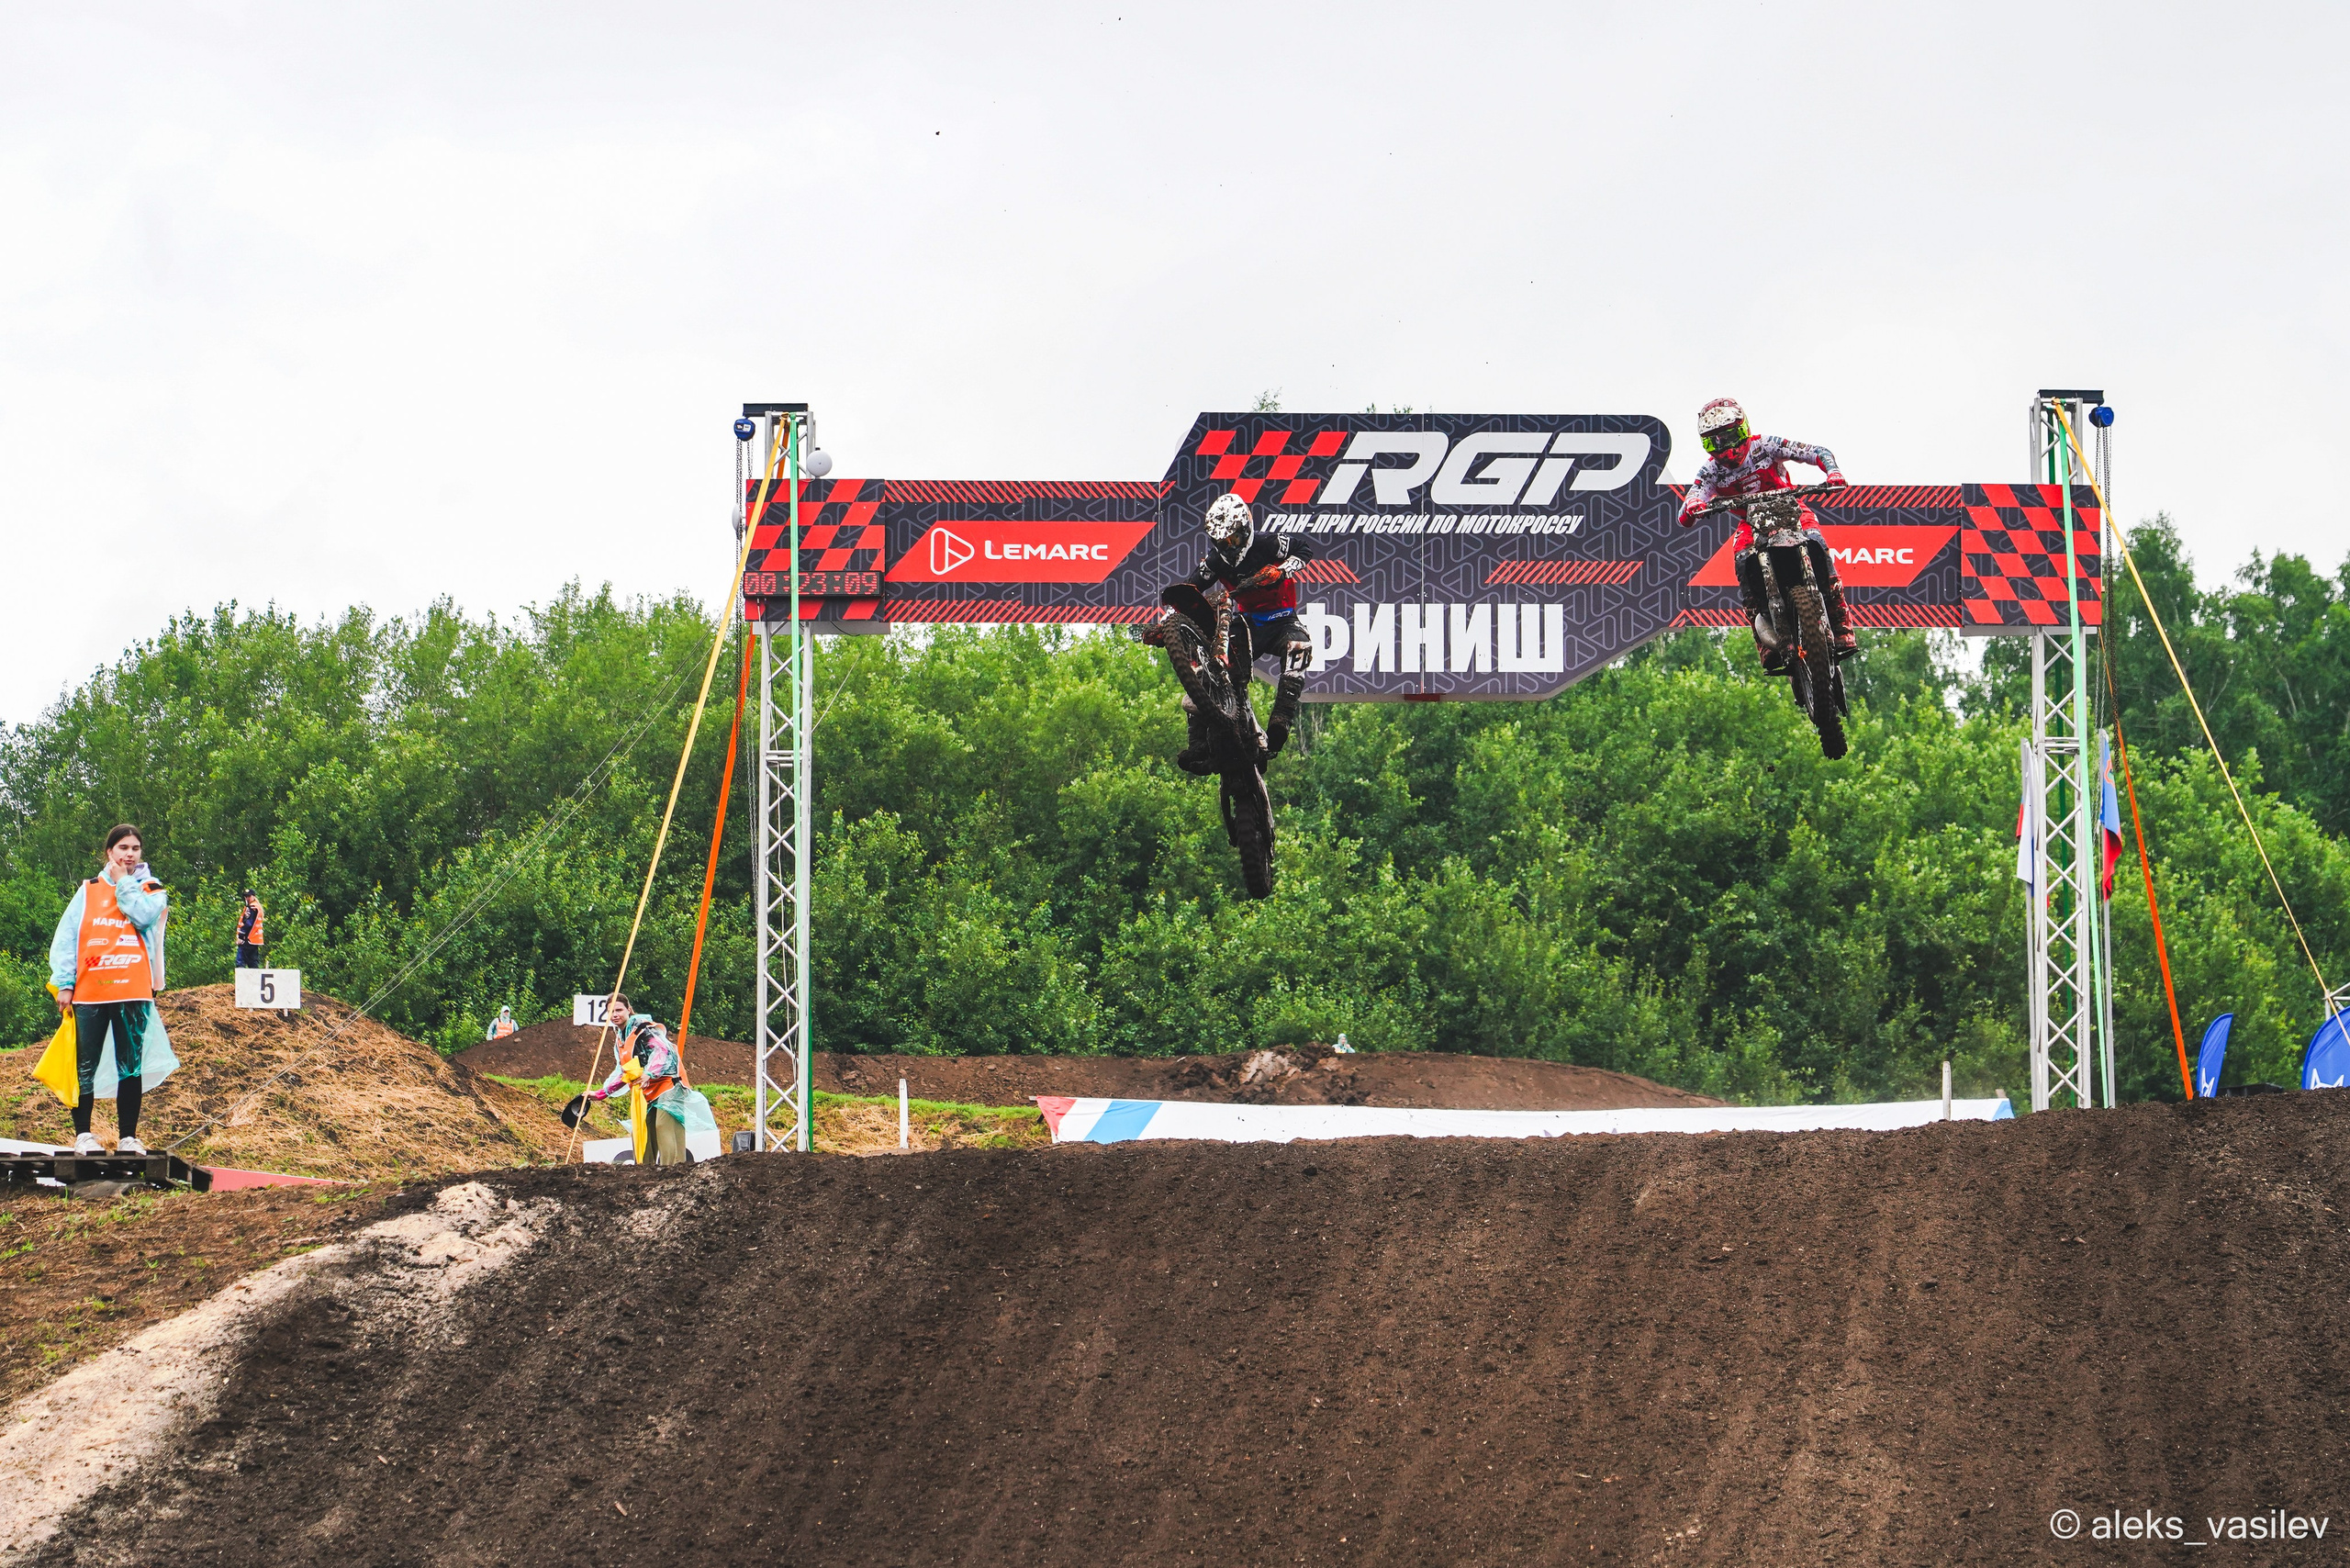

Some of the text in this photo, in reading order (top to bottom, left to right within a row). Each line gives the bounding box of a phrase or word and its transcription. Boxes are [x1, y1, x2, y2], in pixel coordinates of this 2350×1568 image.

[1316, 431, 1651, 506] RGP
[1260, 513, 1584, 534] ГРАН-ПРИ РОССИИ ПО МОТОКРОССУ
[984, 540, 1108, 561] LEMARC
[1829, 547, 1914, 565] MARC
[1300, 602, 1565, 673] ФИНИШ
[98, 954, 142, 966] RGP
[260, 973, 275, 1004] 5
[588, 999, 608, 1023] 12
